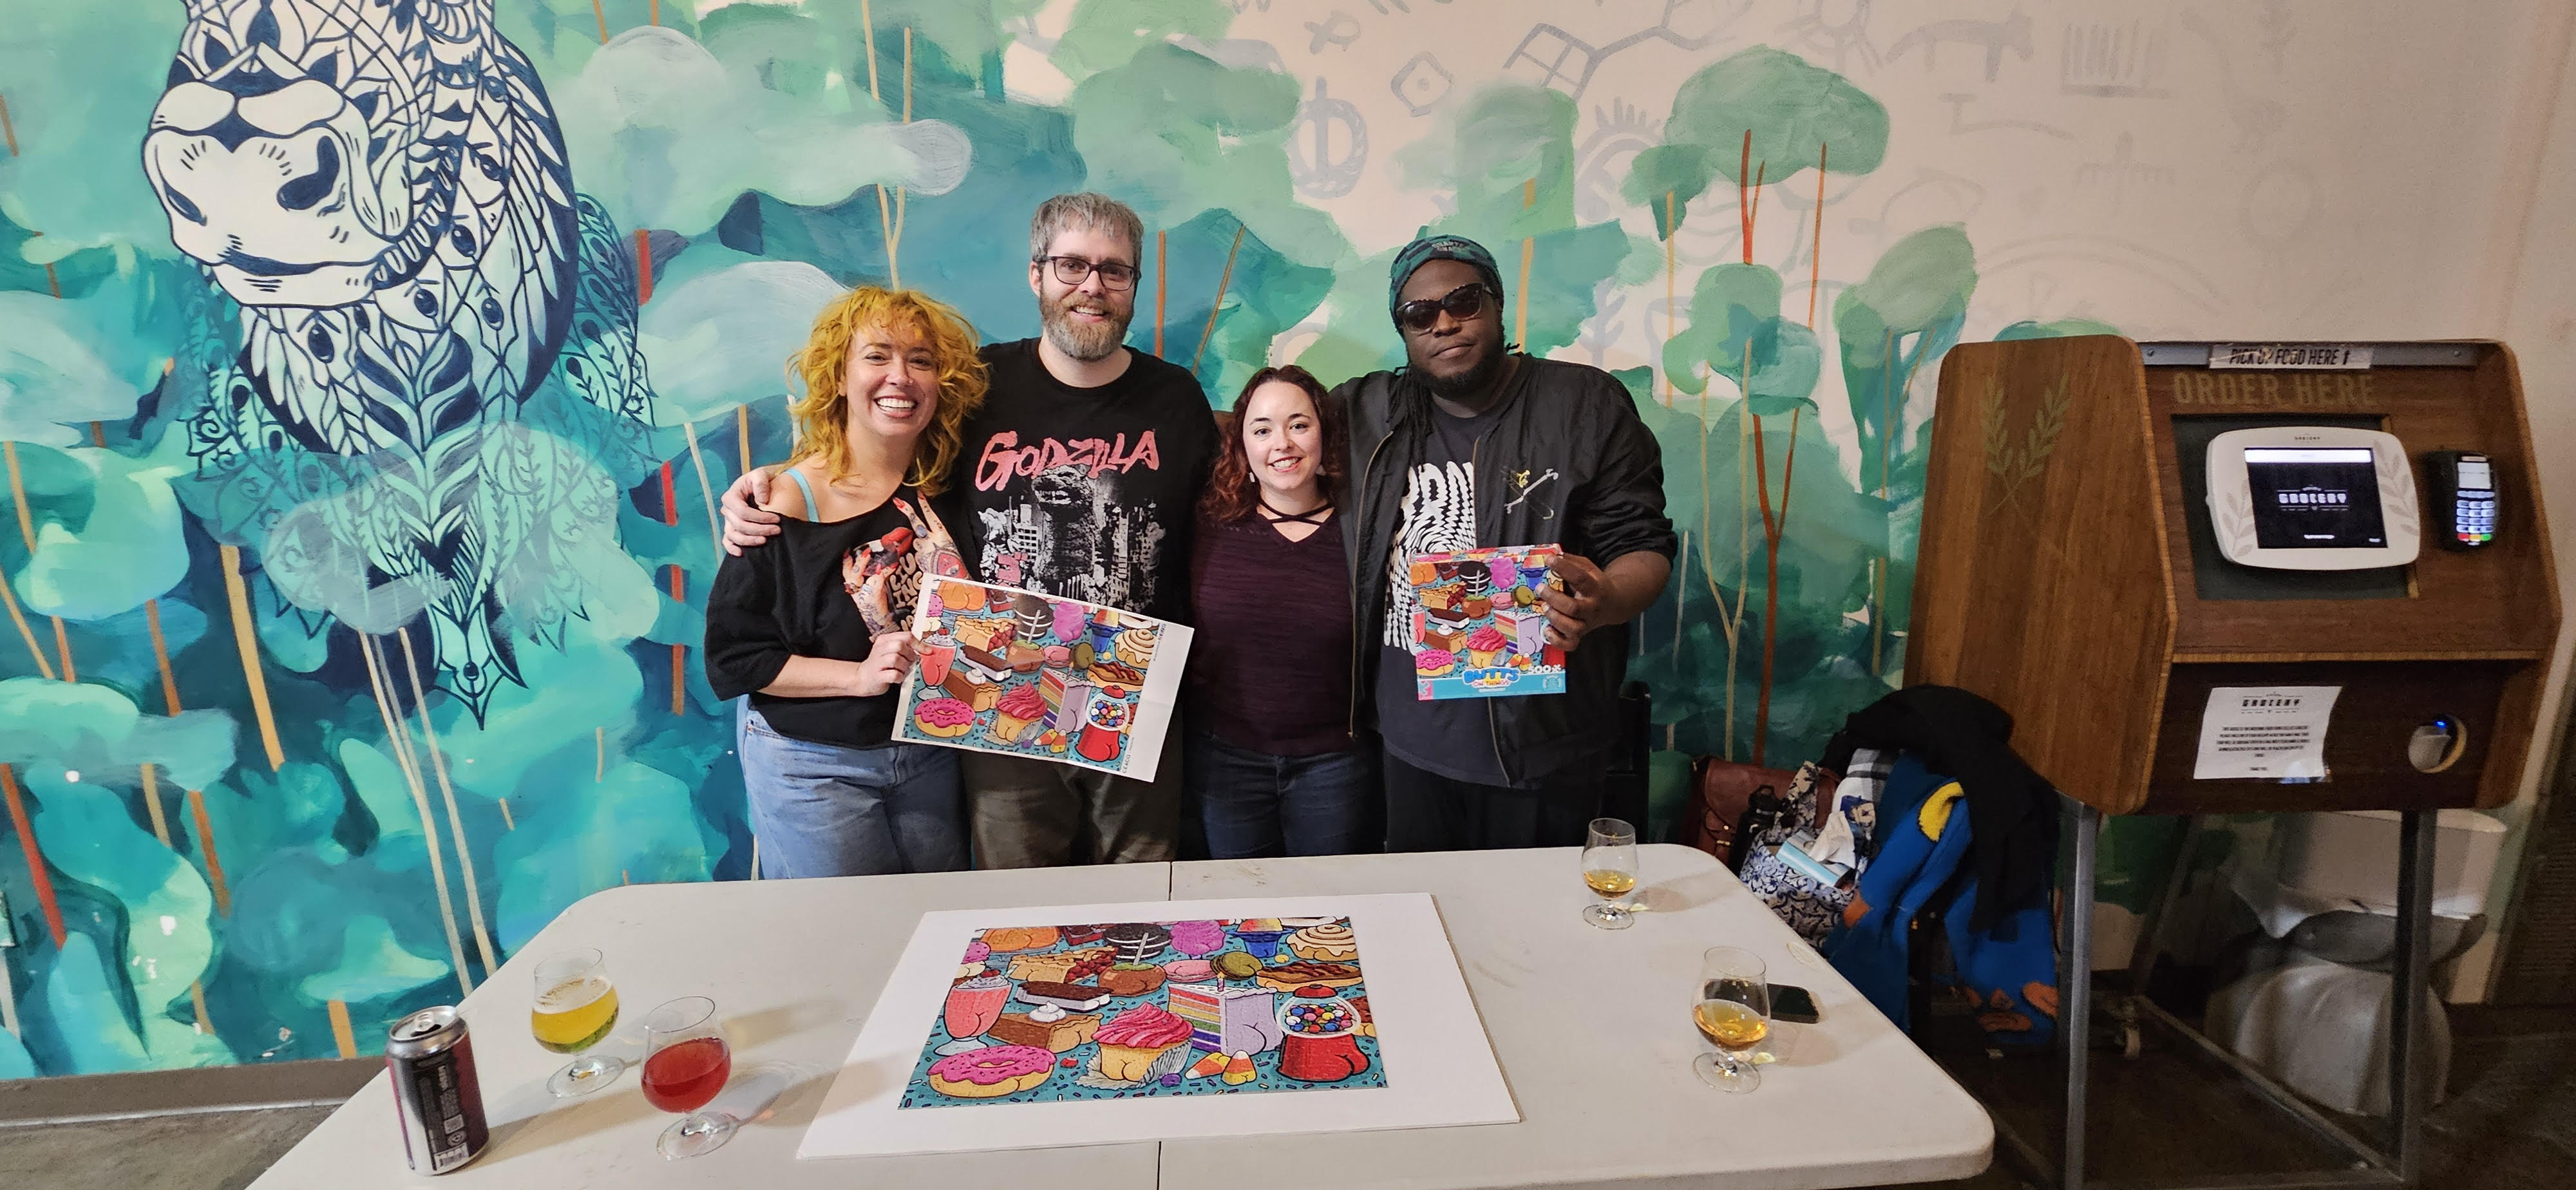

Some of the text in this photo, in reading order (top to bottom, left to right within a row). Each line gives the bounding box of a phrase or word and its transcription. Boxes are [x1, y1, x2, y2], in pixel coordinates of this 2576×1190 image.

[2230, 348, 2257, 364] PICK
[2275, 349, 2306, 364] FOOD
[2307, 349, 2339, 364] HERE
[2174, 372, 2376, 405] ORDER HERE
[975, 430, 1159, 491] GODZILLA
[1463, 668, 1519, 683] BUTTS
